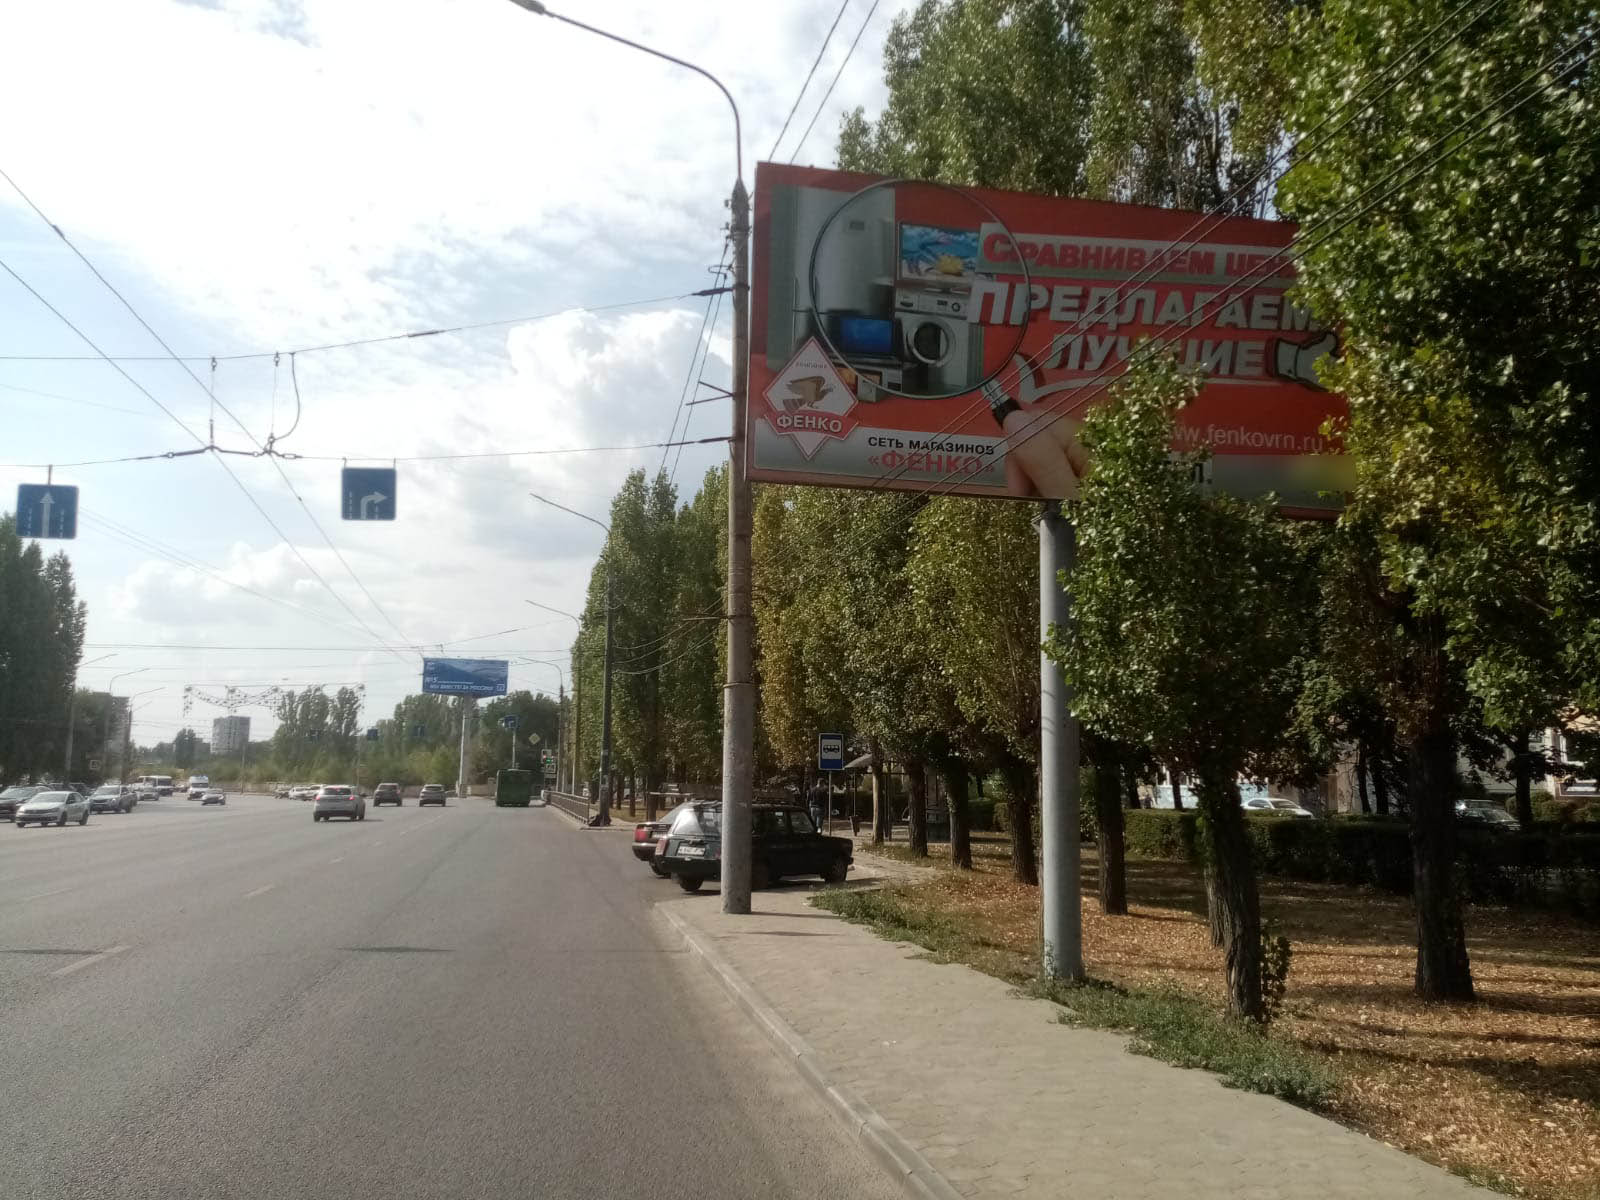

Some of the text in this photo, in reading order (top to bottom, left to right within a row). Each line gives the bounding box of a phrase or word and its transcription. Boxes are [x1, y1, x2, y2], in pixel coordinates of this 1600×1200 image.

[982, 233, 1217, 276] СРАВНИВАЕМ
[966, 278, 1324, 332] ПРЕДЛАГАЕМ
[776, 414, 842, 433] ФЕНКО
[867, 436, 995, 456] СЕТЬ МАГАЗИНОВ
[867, 450, 995, 475] «ФЕНКО»
